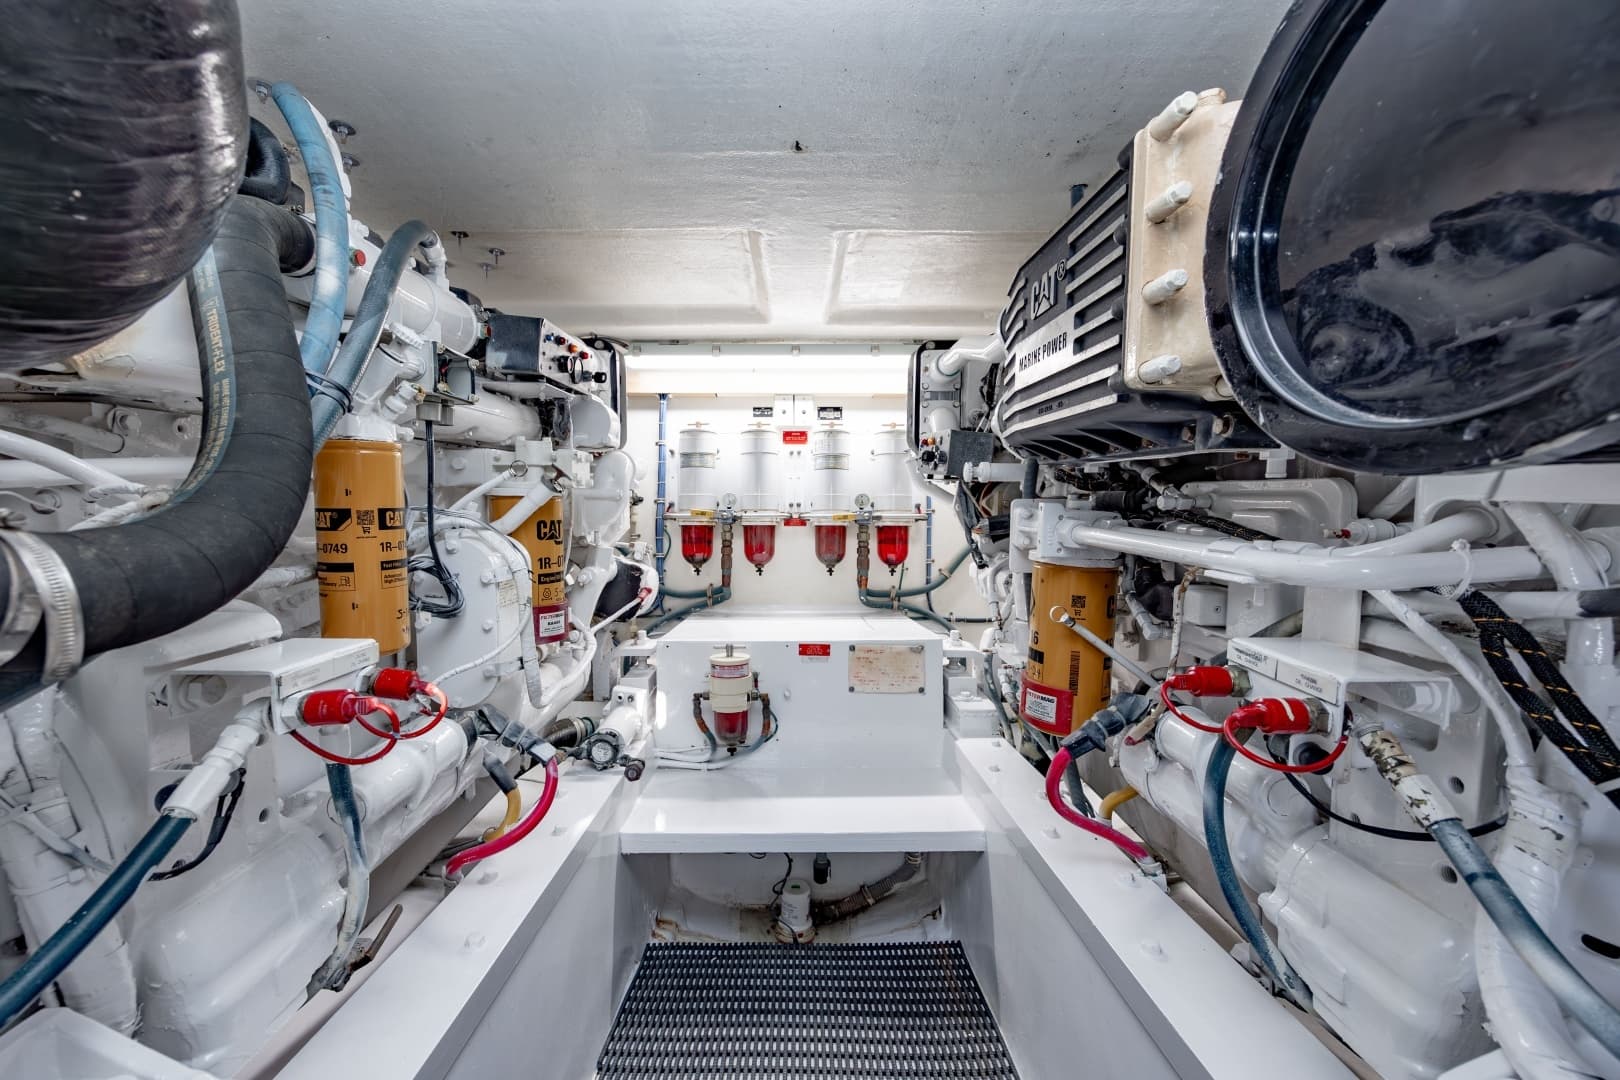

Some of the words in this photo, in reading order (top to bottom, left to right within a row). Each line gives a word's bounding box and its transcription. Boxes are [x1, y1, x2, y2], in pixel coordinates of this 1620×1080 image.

[1019, 346, 1041, 372] MARINE
[1042, 332, 1068, 360] POWER
[536, 519, 563, 541] CAT
